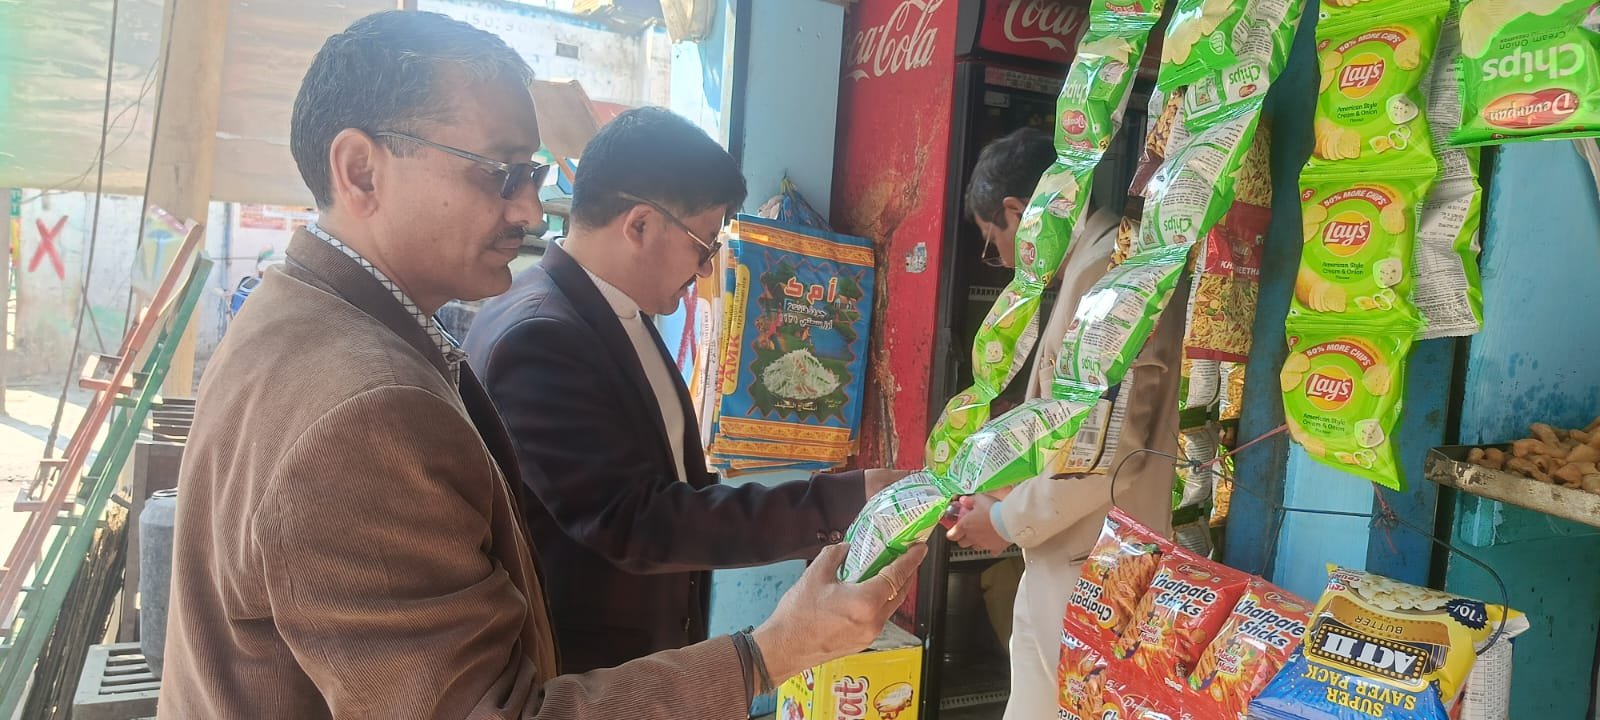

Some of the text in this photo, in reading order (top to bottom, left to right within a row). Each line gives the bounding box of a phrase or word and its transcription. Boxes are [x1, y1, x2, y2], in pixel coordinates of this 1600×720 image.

[847, 0, 943, 77] ca-Cola
[1339, 32, 1402, 53] 50% MORE CHIPS
[1499, 39, 1529, 51] Onion
[1532, 31, 1566, 43] Cream
[1482, 42, 1586, 83] Chips
[1228, 65, 1260, 85] Chips
[1340, 62, 1384, 89] Lay's
[1337, 102, 1378, 113] American Style
[1337, 112, 1355, 120] Cream
[1360, 109, 1378, 117] Onion
[1489, 92, 1575, 121] Devarpan
[1323, 189, 1387, 206] 50% MORE CHIPS
[1164, 215, 1193, 233] Chips
[1324, 222, 1369, 246] Lay's
[725, 334, 741, 383] AMK
[1307, 344, 1371, 366] 50% MORE CHIPS
[1307, 374, 1351, 401] Lay's
[1303, 413, 1345, 426] American Style
[1328, 423, 1345, 431] Onion
[1156, 592, 1202, 617] Sticks
[1239, 621, 1288, 648] Sticks
[1353, 615, 1404, 635] BUTTER
[1321, 632, 1418, 674] ACT II
[1217, 660, 1238, 674] Munch
[1304, 664, 1417, 710] SAVER PACK
[1326, 687, 1384, 717] SUPER
